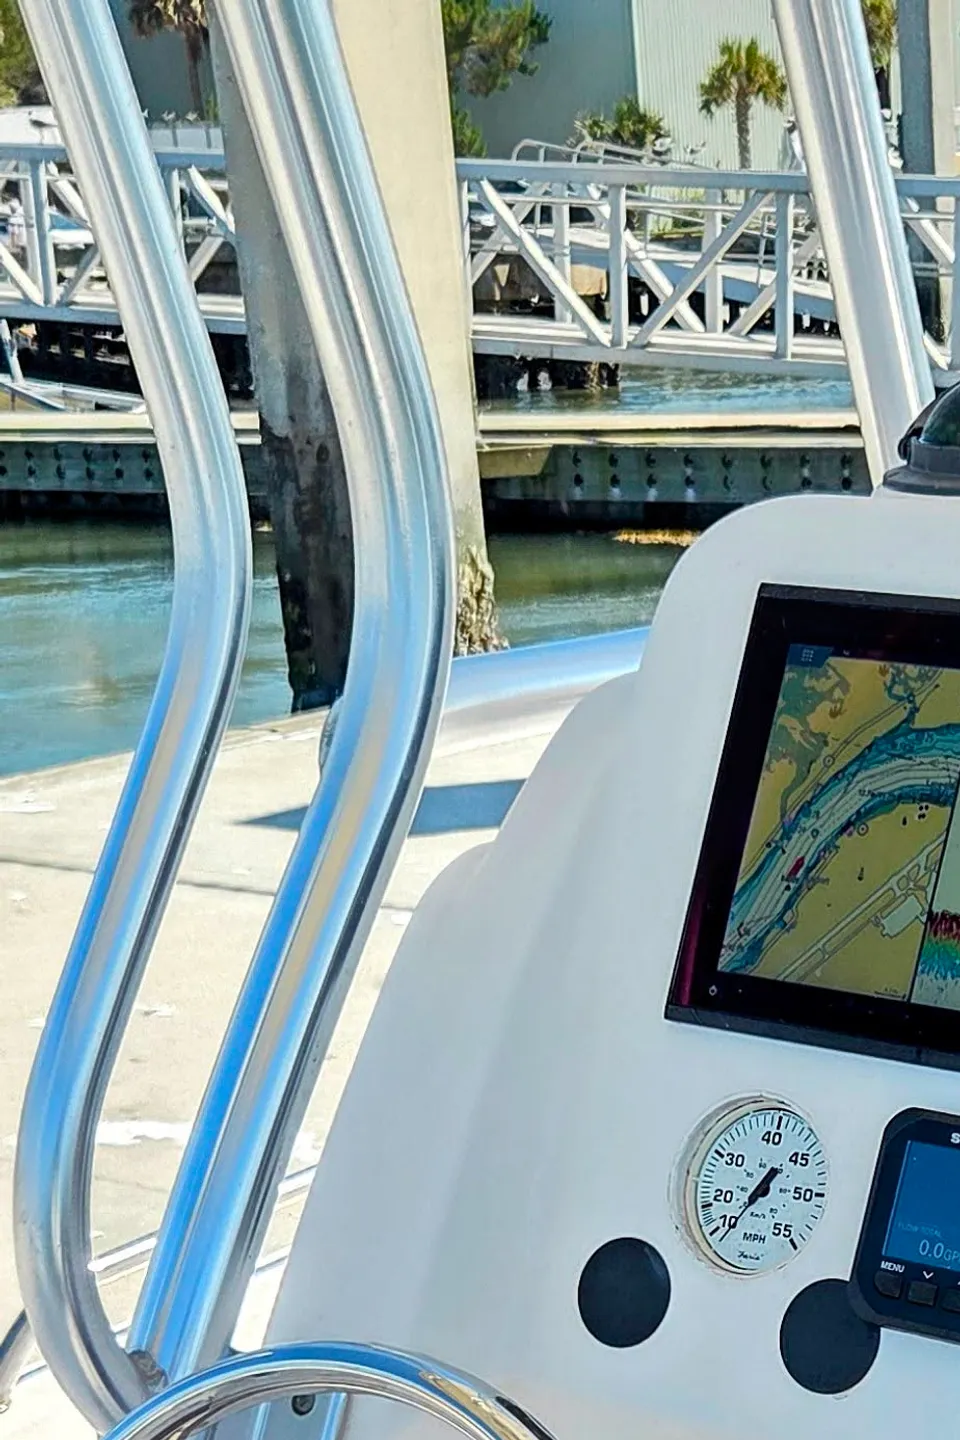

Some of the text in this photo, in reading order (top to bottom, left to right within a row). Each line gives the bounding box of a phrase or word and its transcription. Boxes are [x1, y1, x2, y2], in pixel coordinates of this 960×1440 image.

[761, 1130, 782, 1146] 40
[725, 1152, 745, 1168] 30
[788, 1151, 810, 1167] 45
[713, 1189, 734, 1203] 20
[792, 1188, 813, 1202] 50
[719, 1214, 738, 1229] 10
[772, 1222, 793, 1238] 55
[742, 1232, 766, 1245] MPH
[918, 1239, 945, 1259] 0.0
[880, 1260, 905, 1273] MENU
